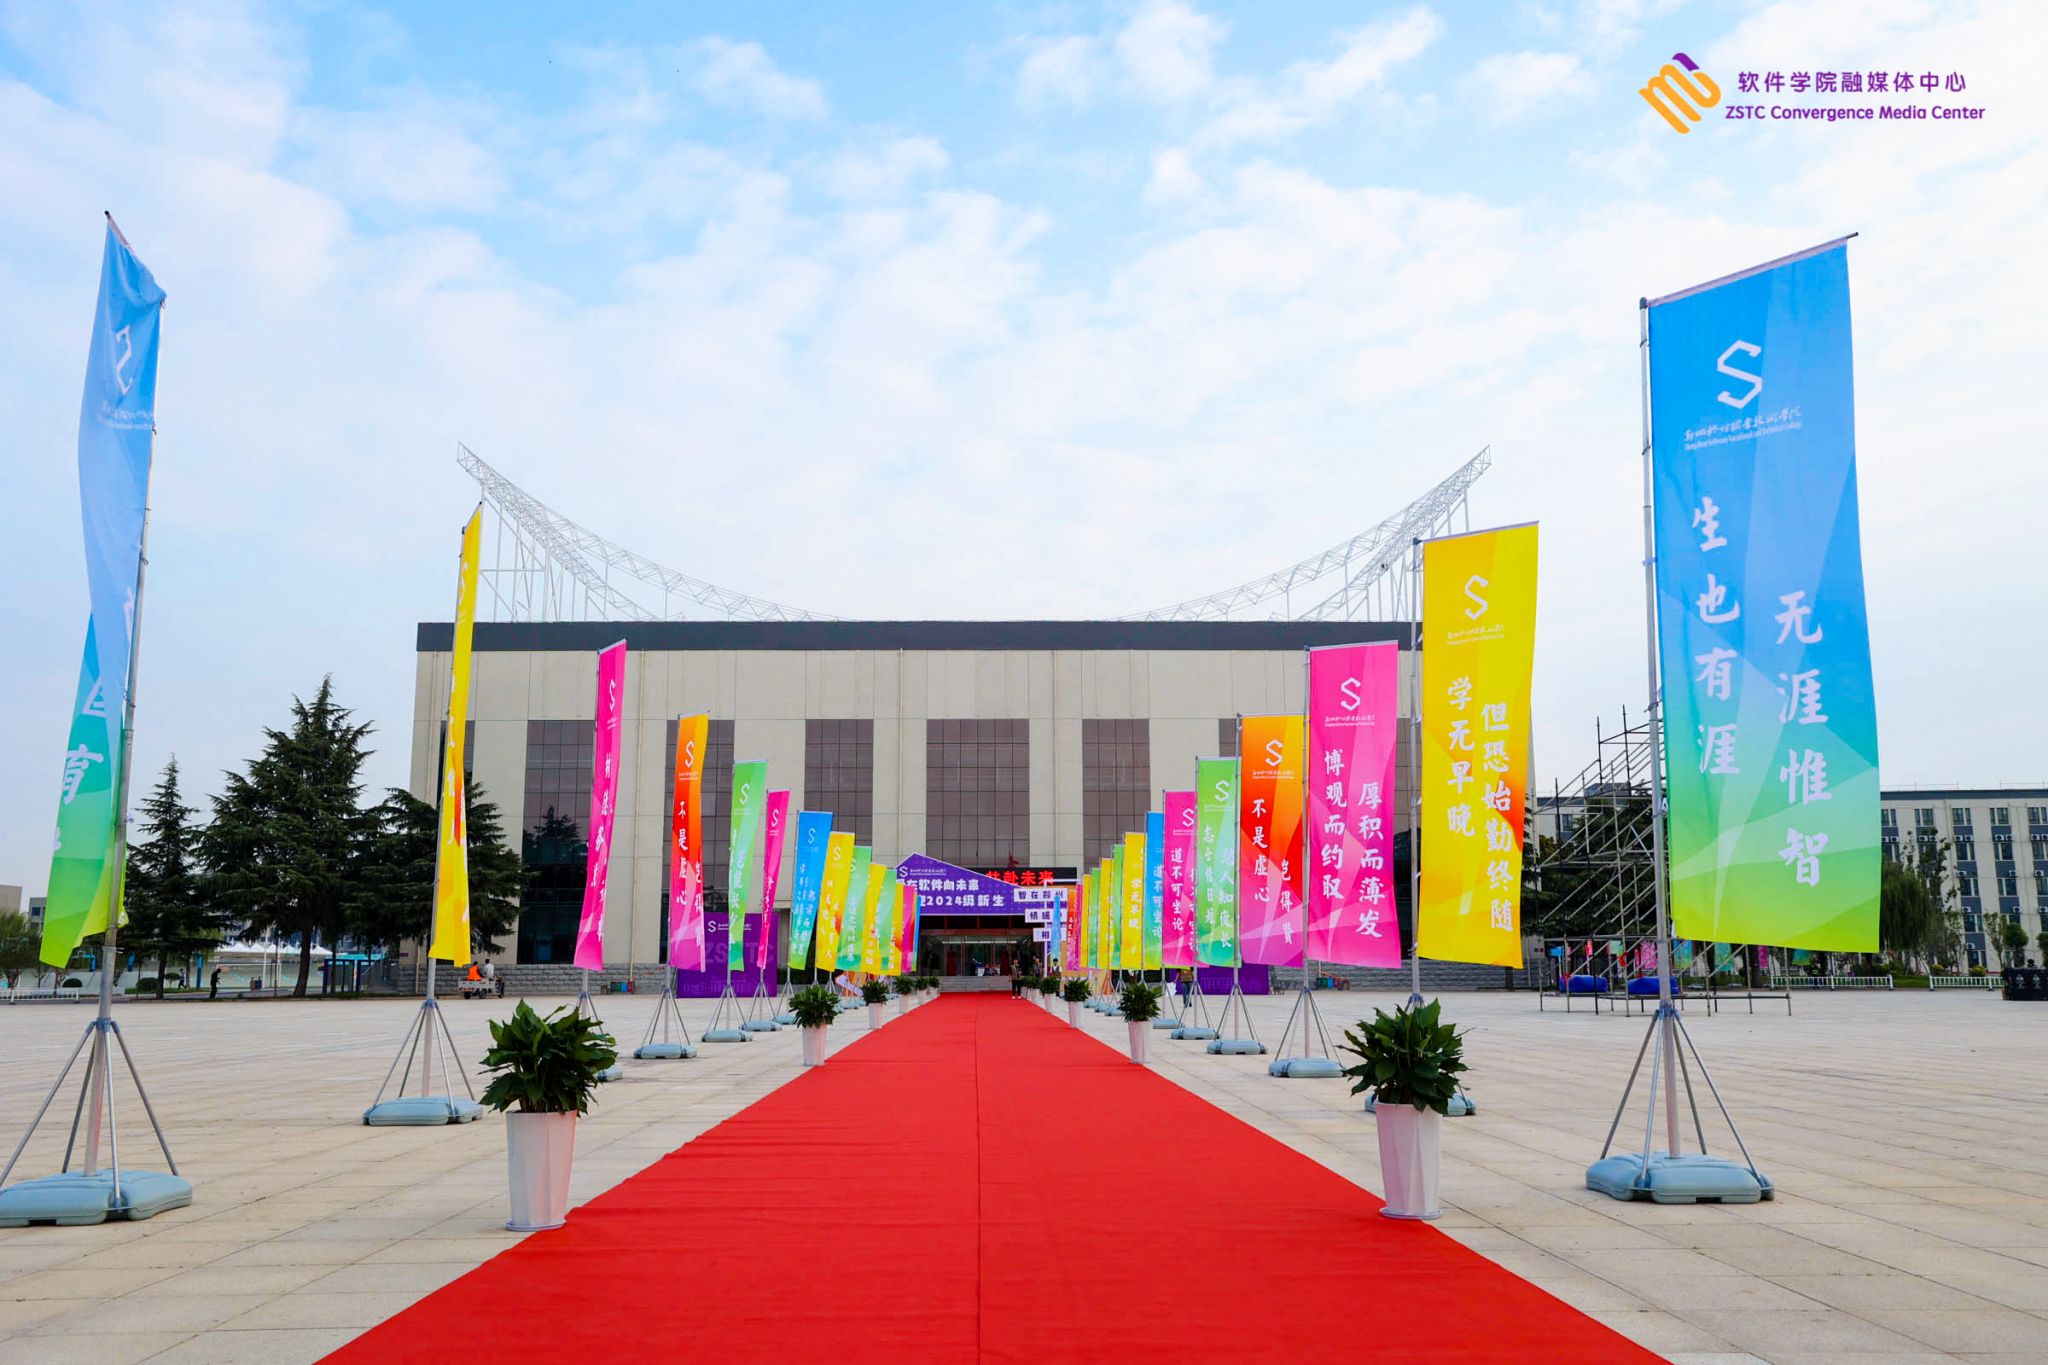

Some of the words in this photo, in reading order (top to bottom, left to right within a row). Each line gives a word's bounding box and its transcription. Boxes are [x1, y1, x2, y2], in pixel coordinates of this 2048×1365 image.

[1691, 496, 1740, 775] 生也有涯
[1447, 677, 1475, 838] 学无早晚
[1481, 702, 1514, 932] 但恐始勤终随
[1774, 590, 1833, 887] 无涯惟智
[1170, 848, 1183, 932] 道不可坐论
[1251, 799, 1270, 903] 不是虚心
[1321, 748, 1347, 900] 博观而约取
[1355, 782, 1386, 938] 厚积而薄发
